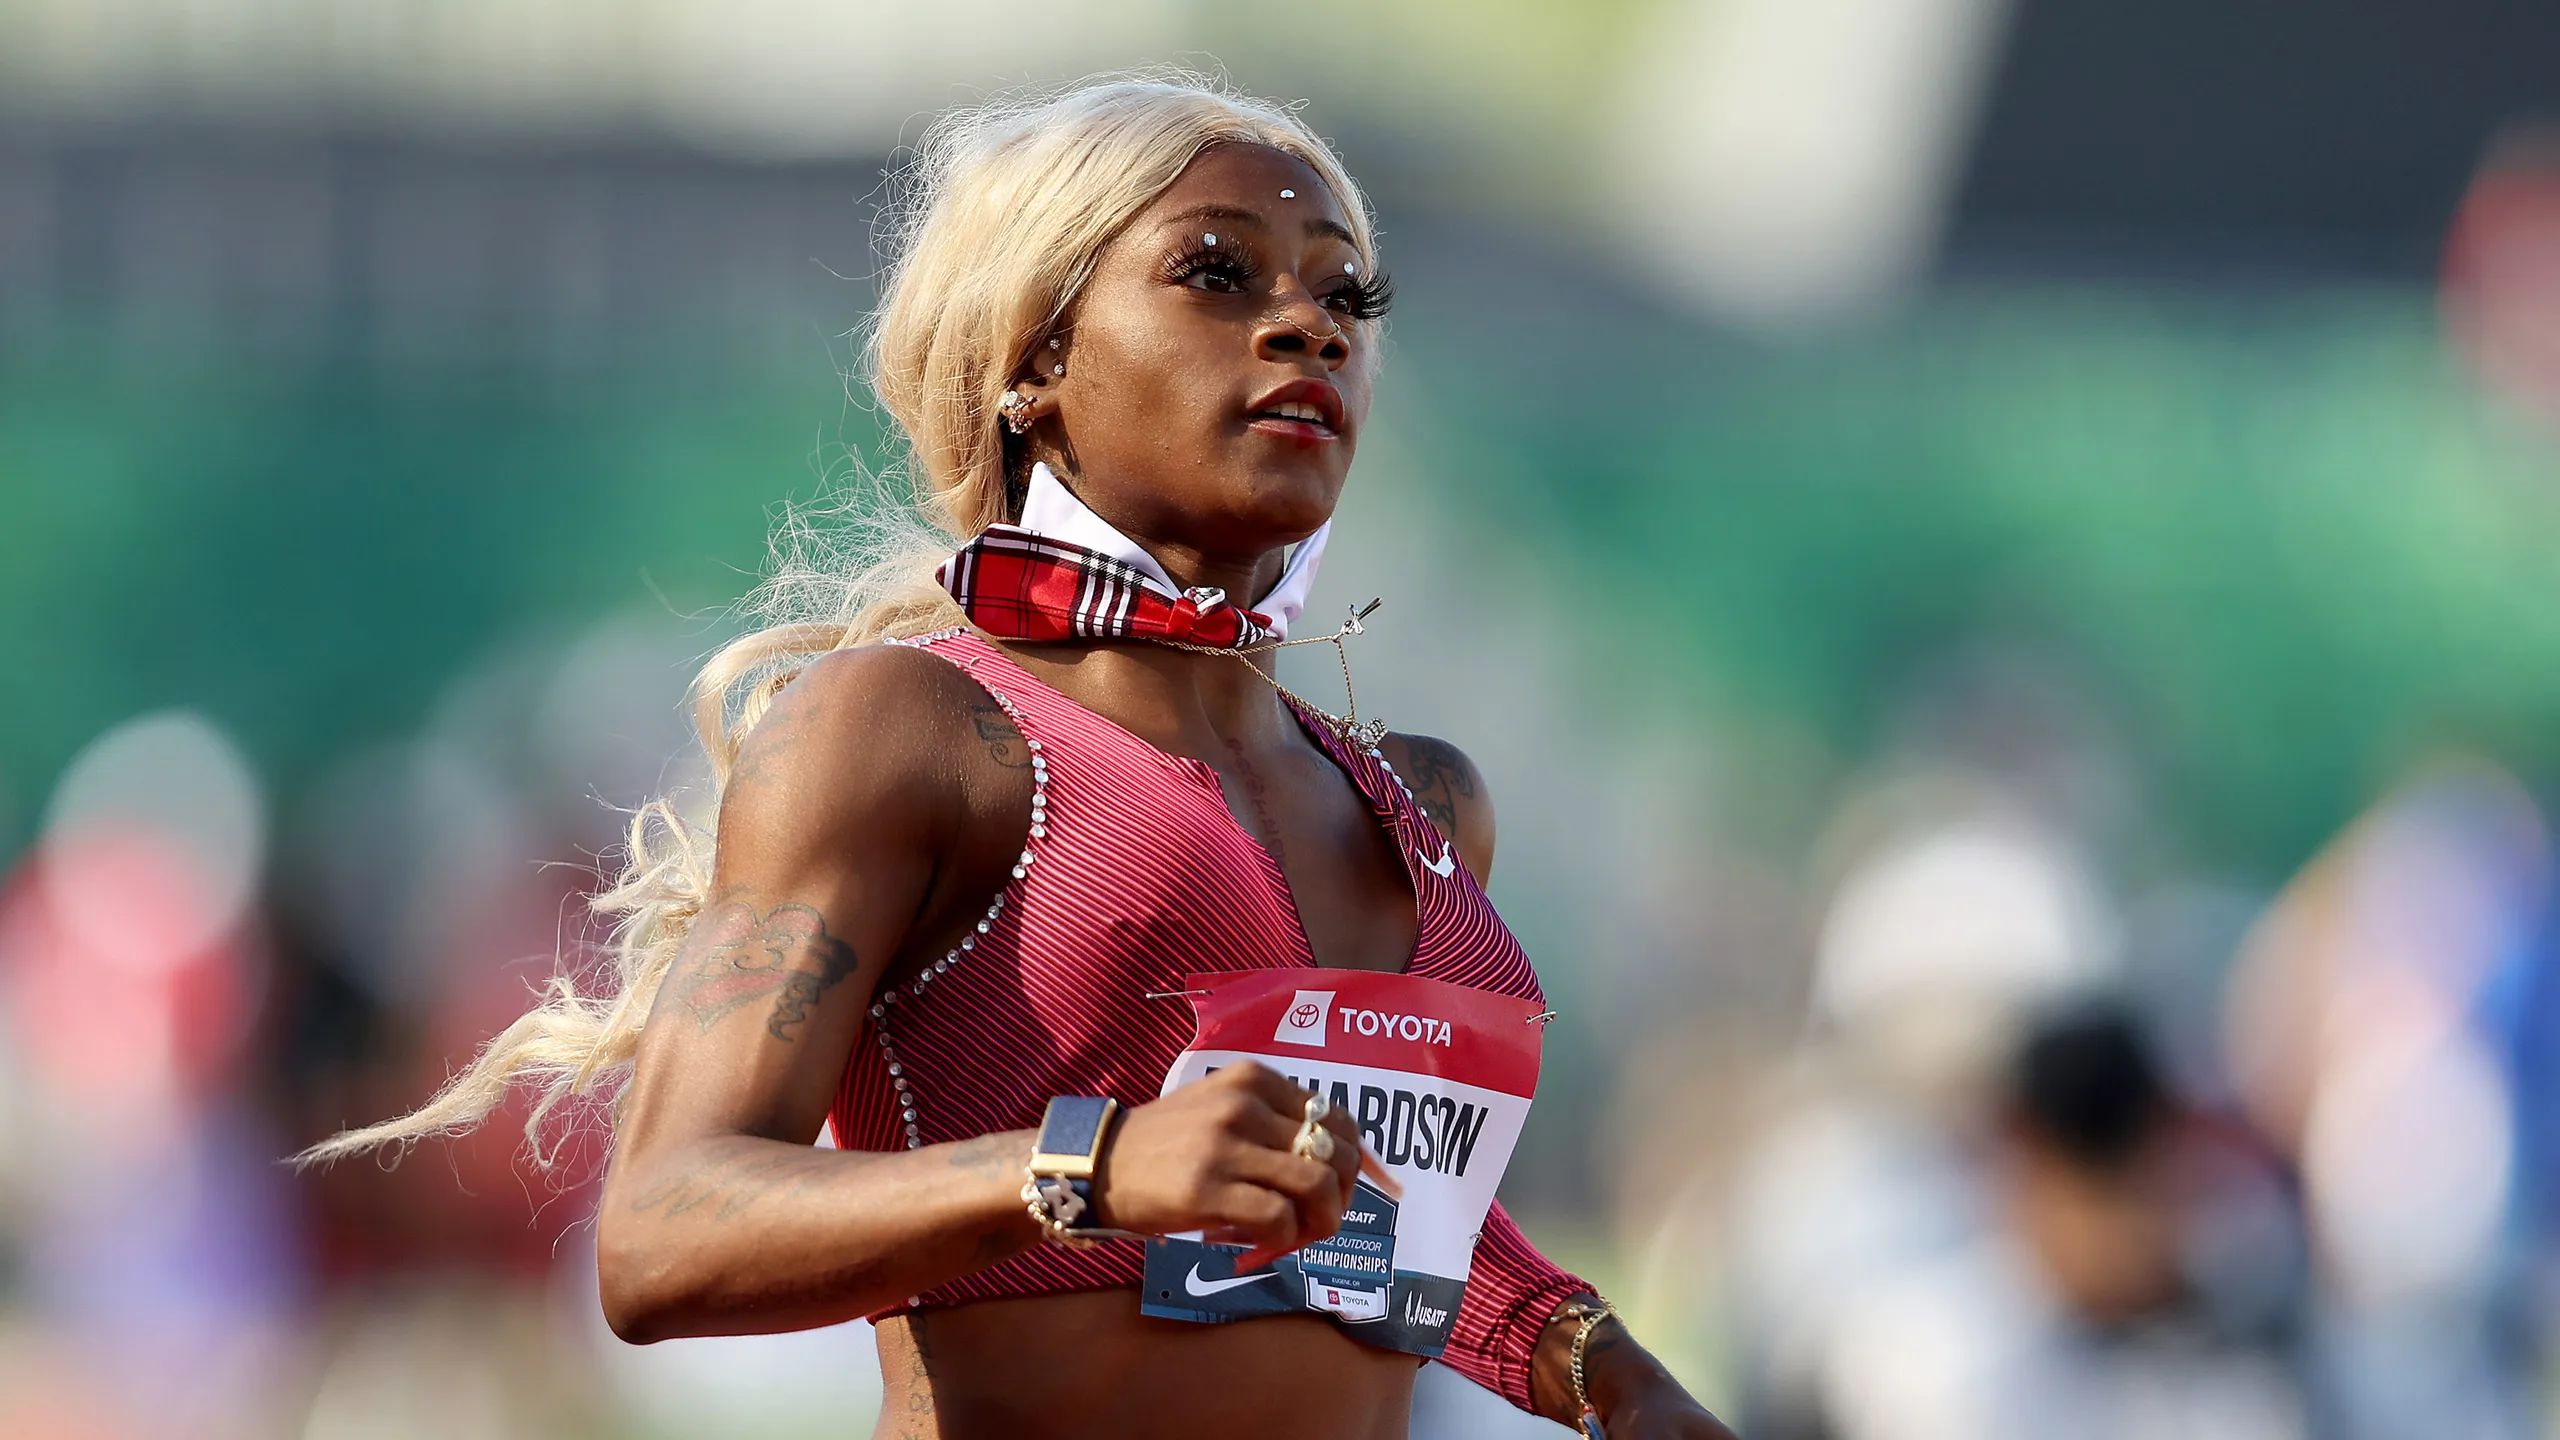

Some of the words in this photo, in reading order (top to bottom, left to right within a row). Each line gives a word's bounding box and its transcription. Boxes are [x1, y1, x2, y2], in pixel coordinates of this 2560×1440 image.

[1339, 1007, 1451, 1047] TOYOTA
[1336, 1237, 1382, 1252] OUTDOOR
[1303, 1247, 1388, 1274] CHAMPIONSHIPS
[1341, 1295, 1370, 1307] TOYOTA
[1418, 1305, 1448, 1328] USATF
